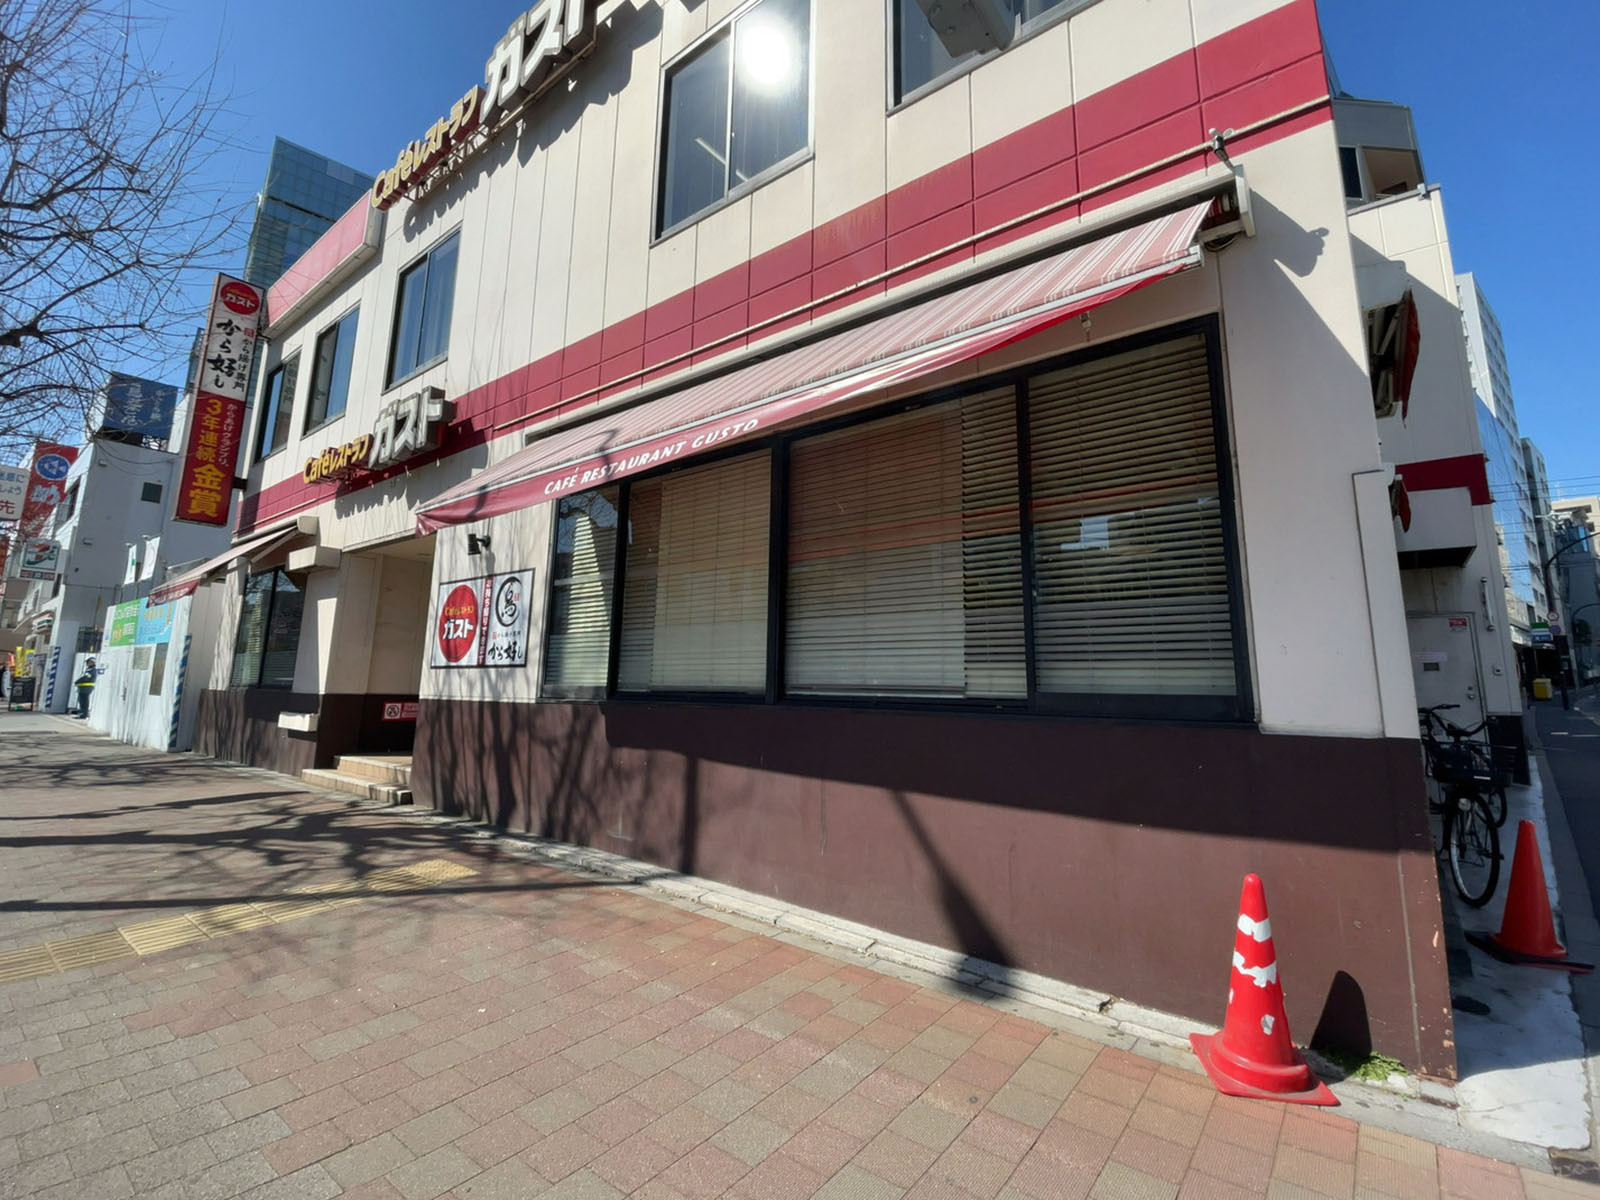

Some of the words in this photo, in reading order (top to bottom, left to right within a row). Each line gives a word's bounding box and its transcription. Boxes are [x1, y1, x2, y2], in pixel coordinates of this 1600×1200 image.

[368, 386, 444, 469] ガスト
[544, 467, 579, 495] CAFÉ
[580, 440, 687, 484] RESTAURANT
[691, 418, 759, 449] GUSTO
[442, 618, 474, 640] ガスト
[487, 640, 523, 662] から好し
